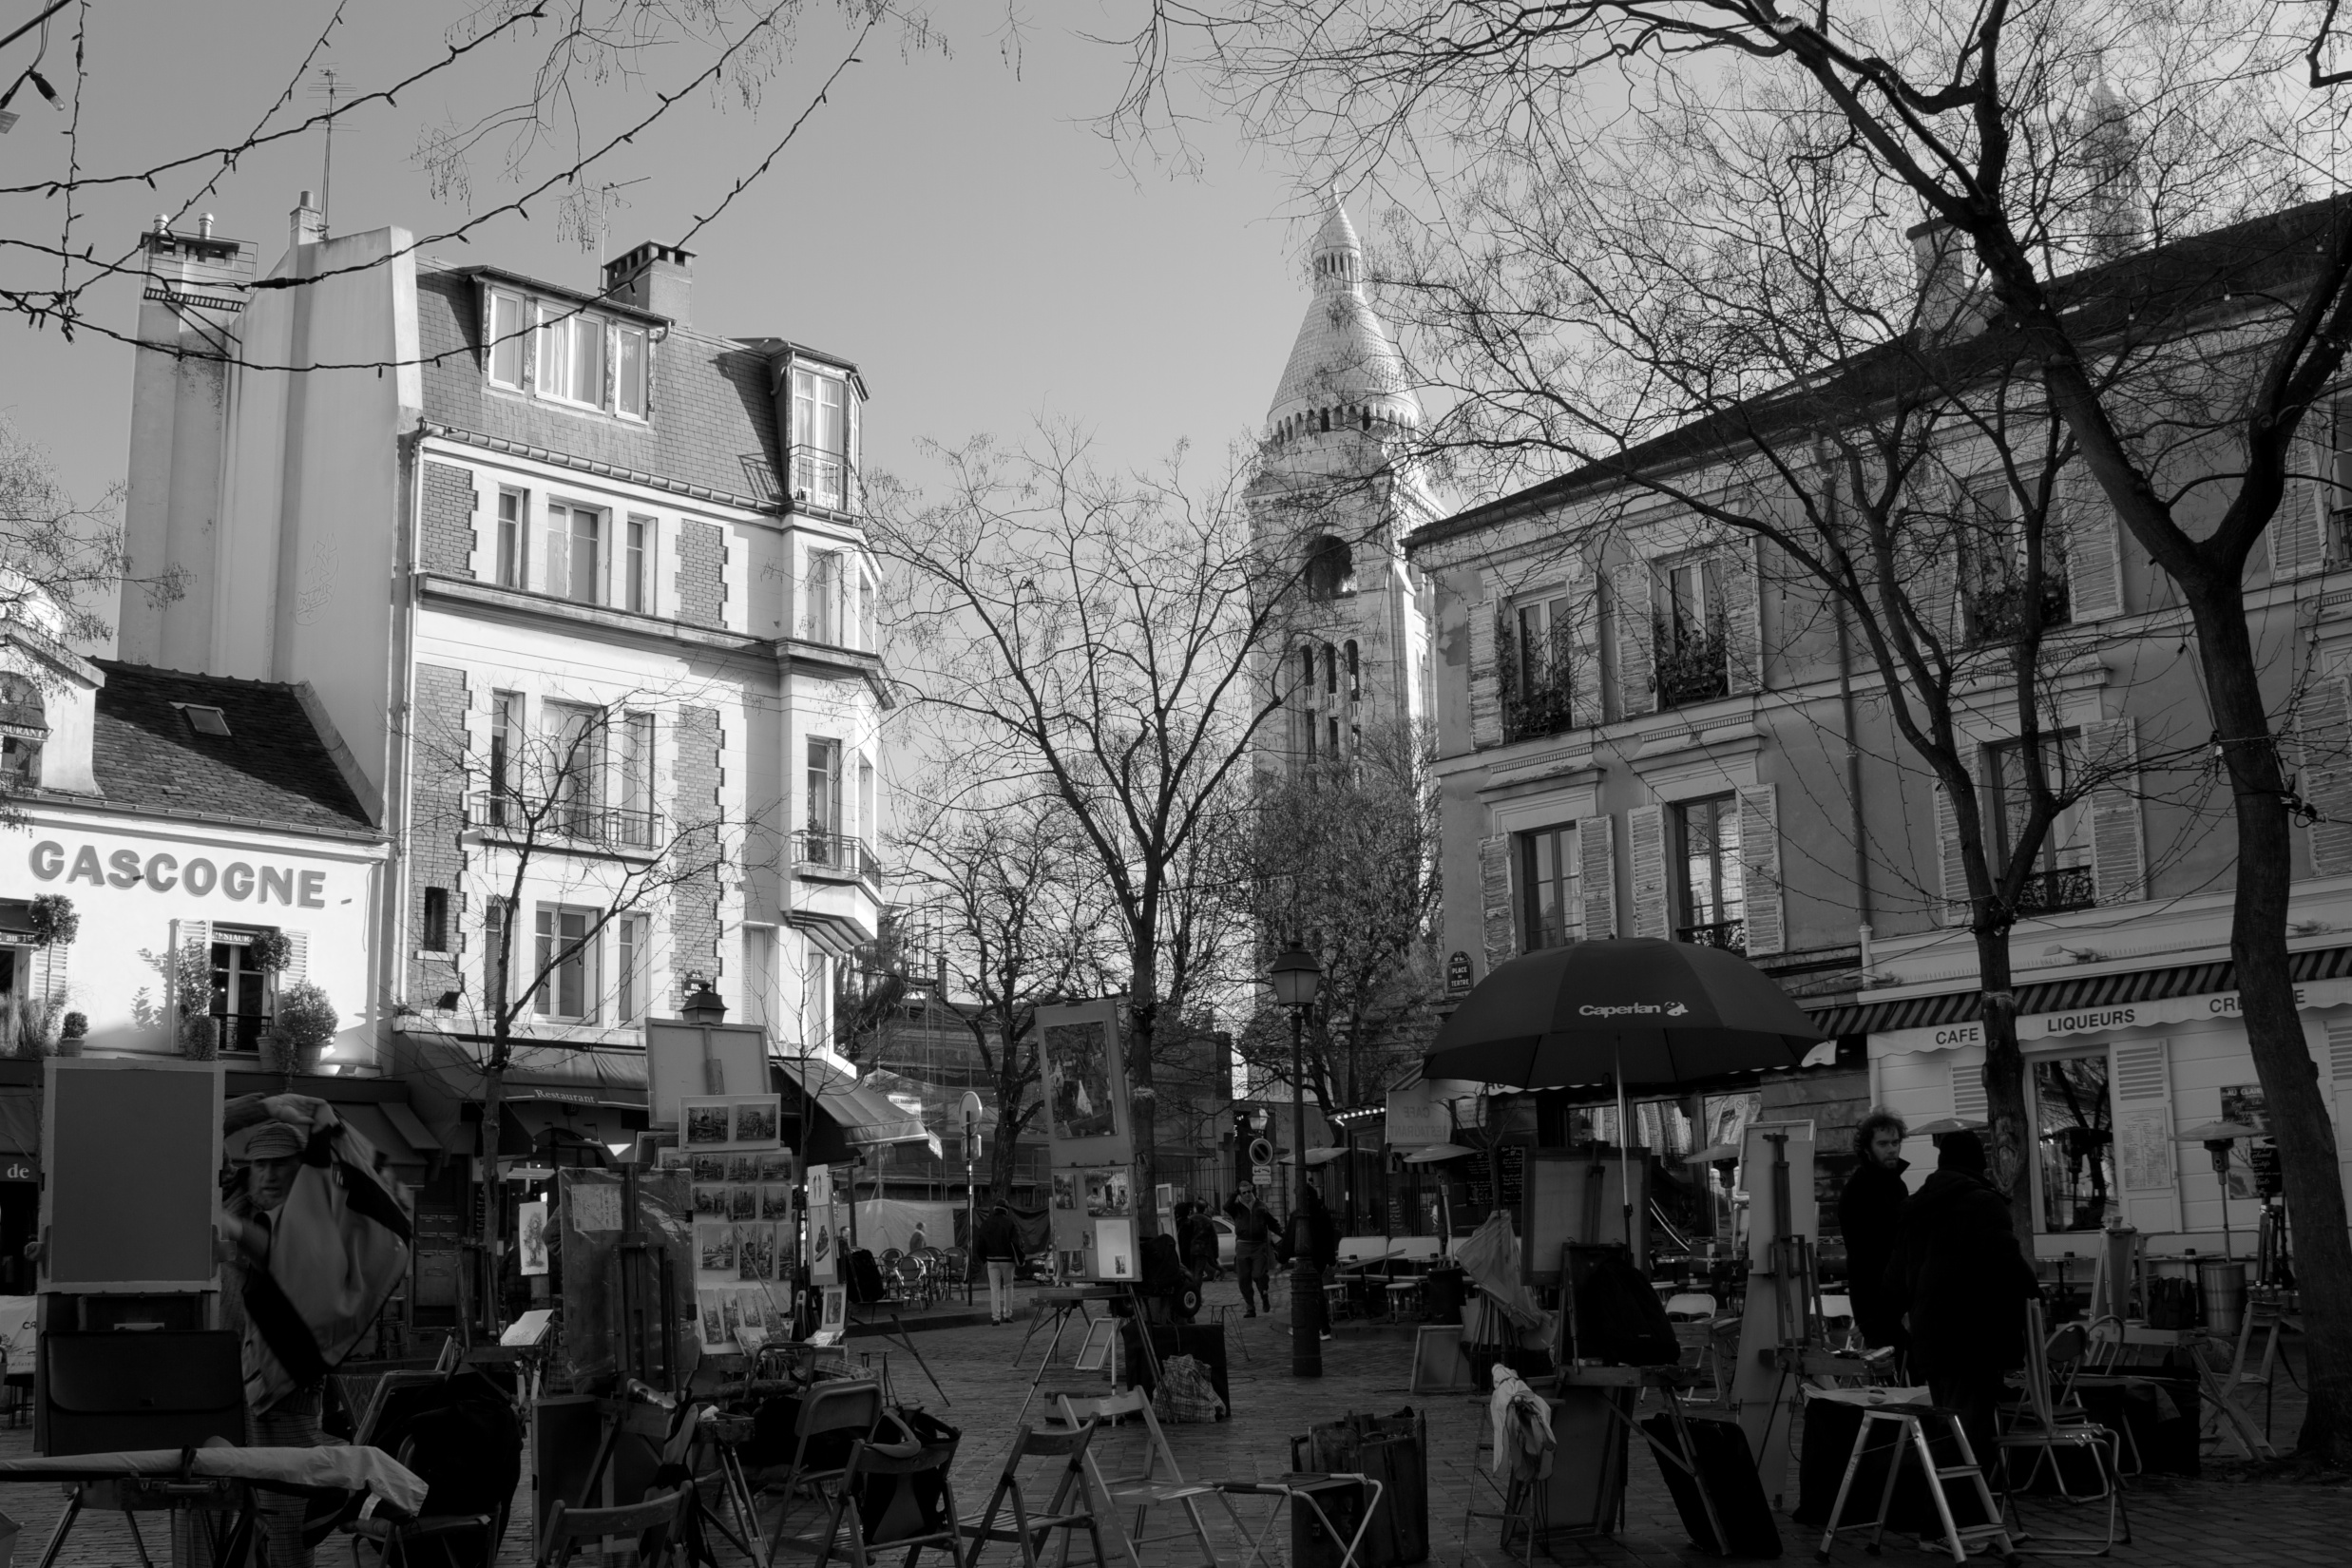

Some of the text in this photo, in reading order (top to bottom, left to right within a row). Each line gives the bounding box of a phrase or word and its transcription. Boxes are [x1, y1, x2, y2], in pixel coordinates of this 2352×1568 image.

[29, 840, 326, 908] GASCOGNE
[1451, 966, 1467, 974] PLACE
[1450, 978, 1470, 986] TERTRE
[1578, 1001, 1661, 1019] Caperlan
[2047, 1008, 2135, 1032] LIQUEURS
[1935, 1027, 1979, 1045] CAFE
[534, 1089, 597, 1103] Restaurant
[7, 1163, 29, 1179] de
